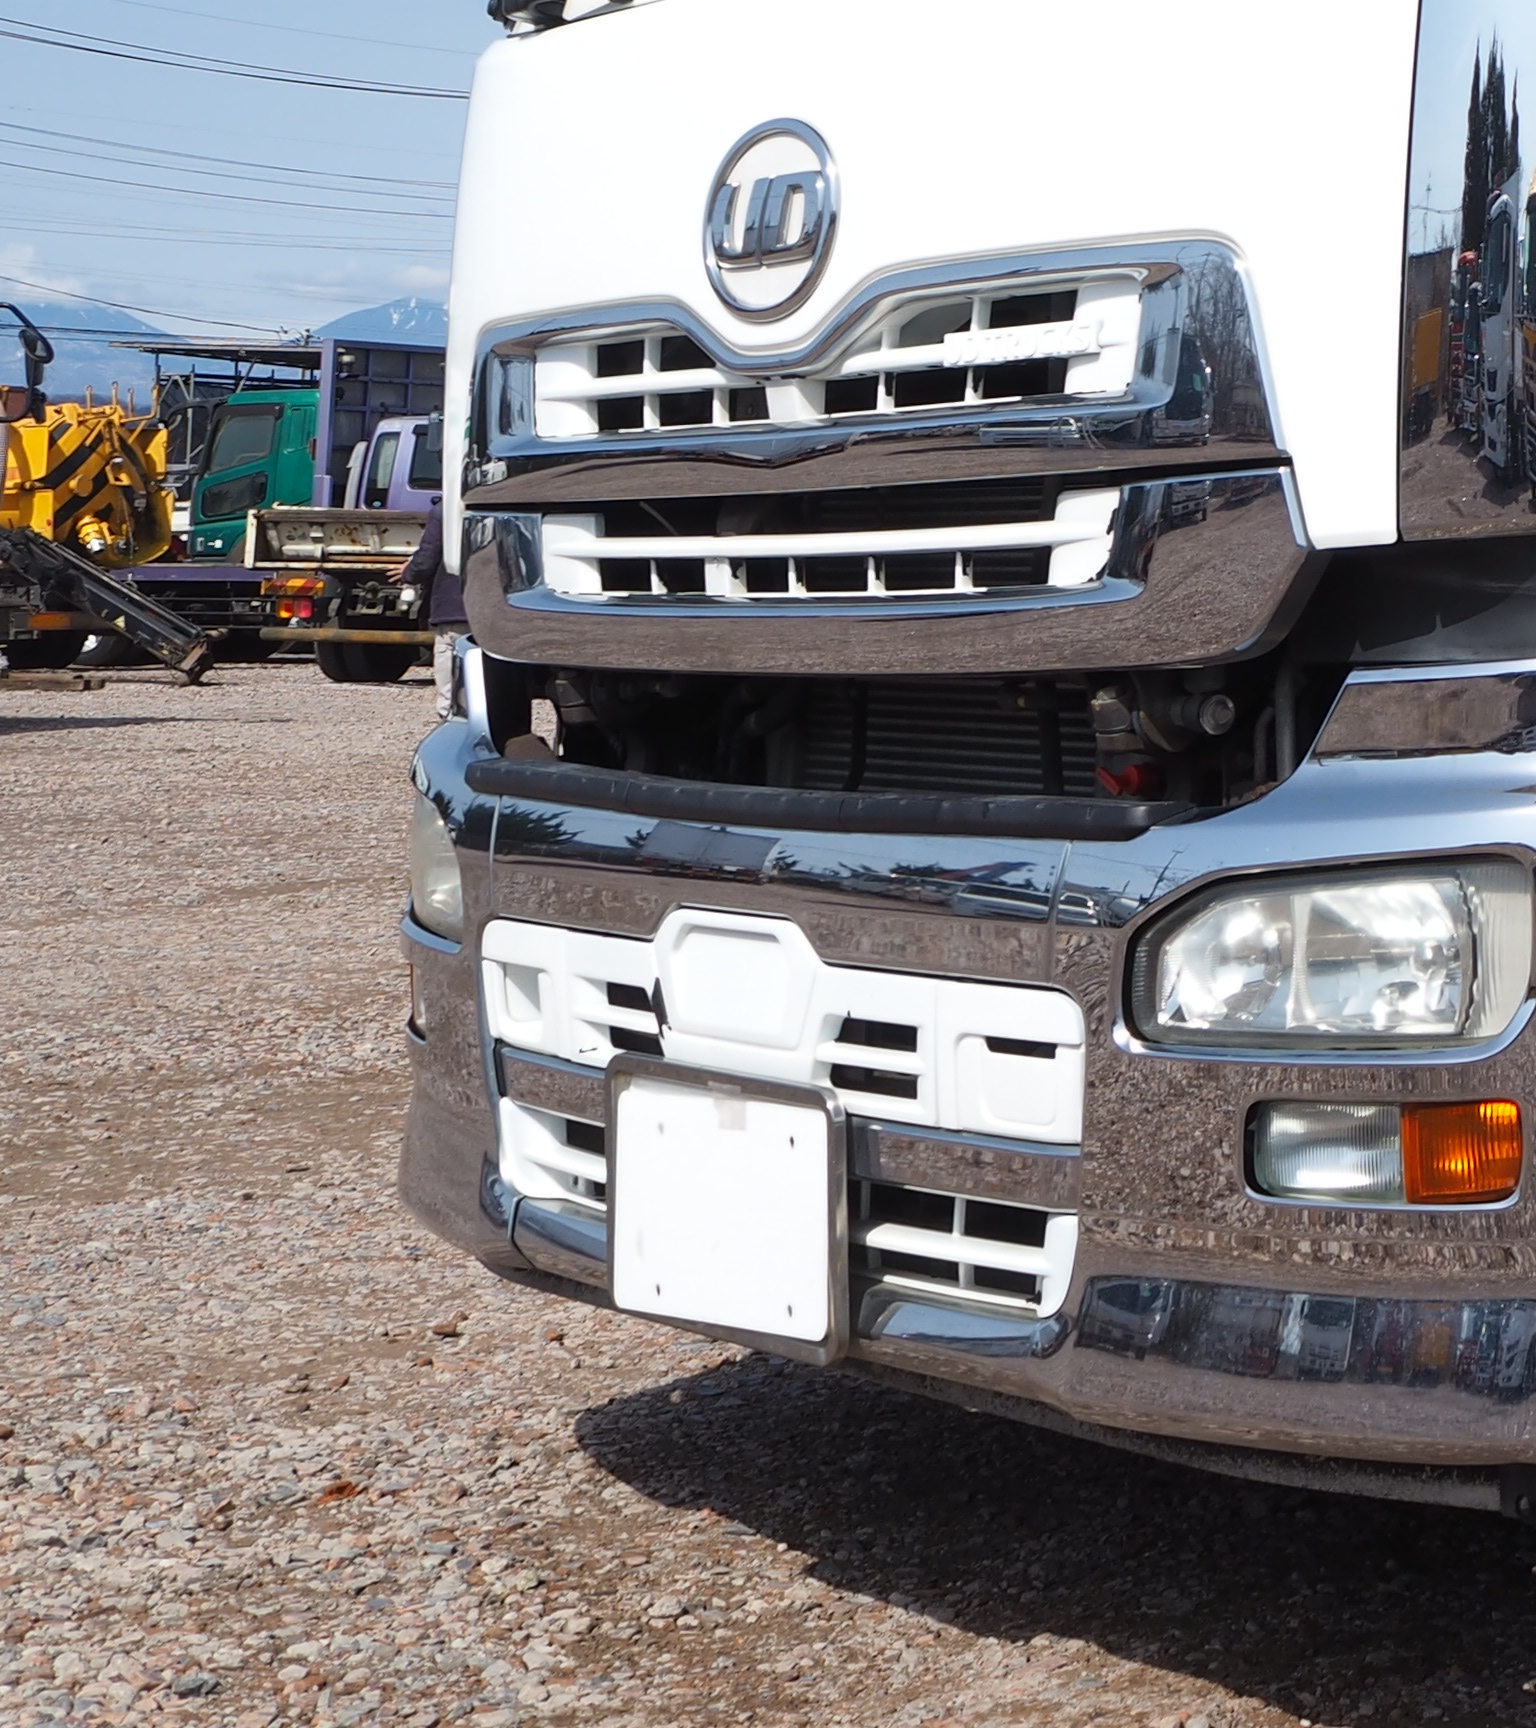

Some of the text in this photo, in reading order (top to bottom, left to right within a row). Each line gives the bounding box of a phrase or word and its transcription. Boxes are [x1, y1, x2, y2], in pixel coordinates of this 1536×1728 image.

[711, 170, 823, 270] UD
[946, 324, 1091, 365] UD TRUCKS
